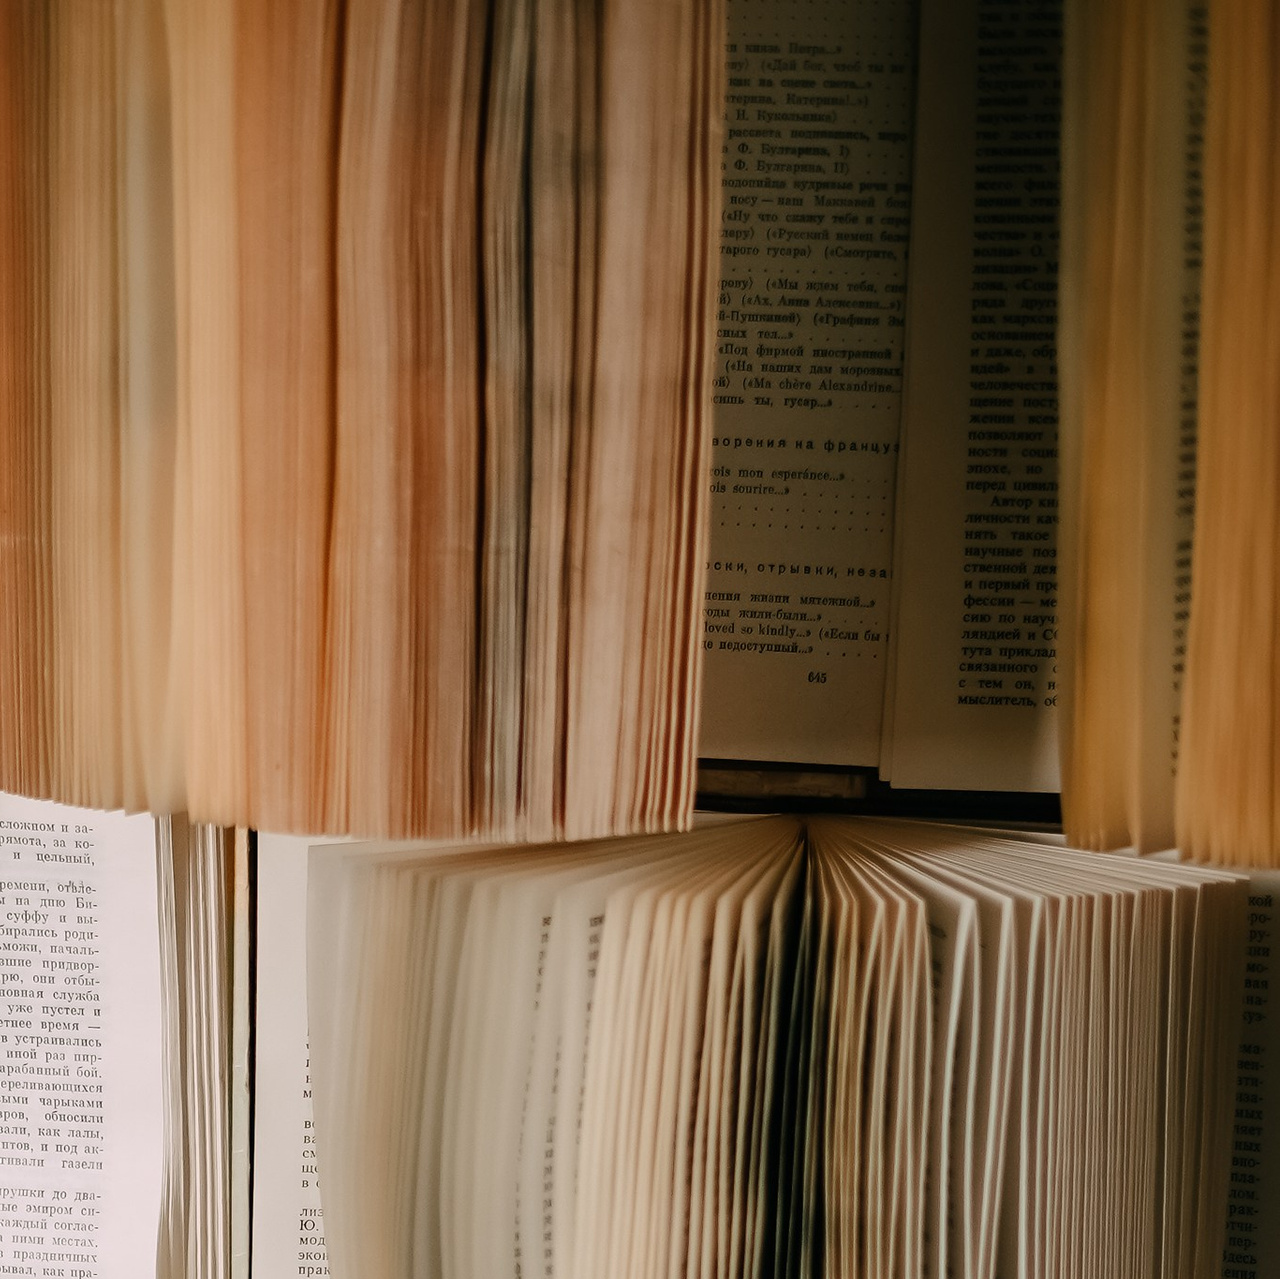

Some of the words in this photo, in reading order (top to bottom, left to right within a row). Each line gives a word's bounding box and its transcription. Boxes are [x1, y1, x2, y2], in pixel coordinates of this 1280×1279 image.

[795, 440, 814, 450] на
[738, 469, 763, 478] mon
[741, 627, 753, 635] so
[808, 671, 827, 684] 645
[0, 820, 55, 832] сложном
[41, 1021, 79, 1032] время
[76, 1066, 102, 1078] бой.
